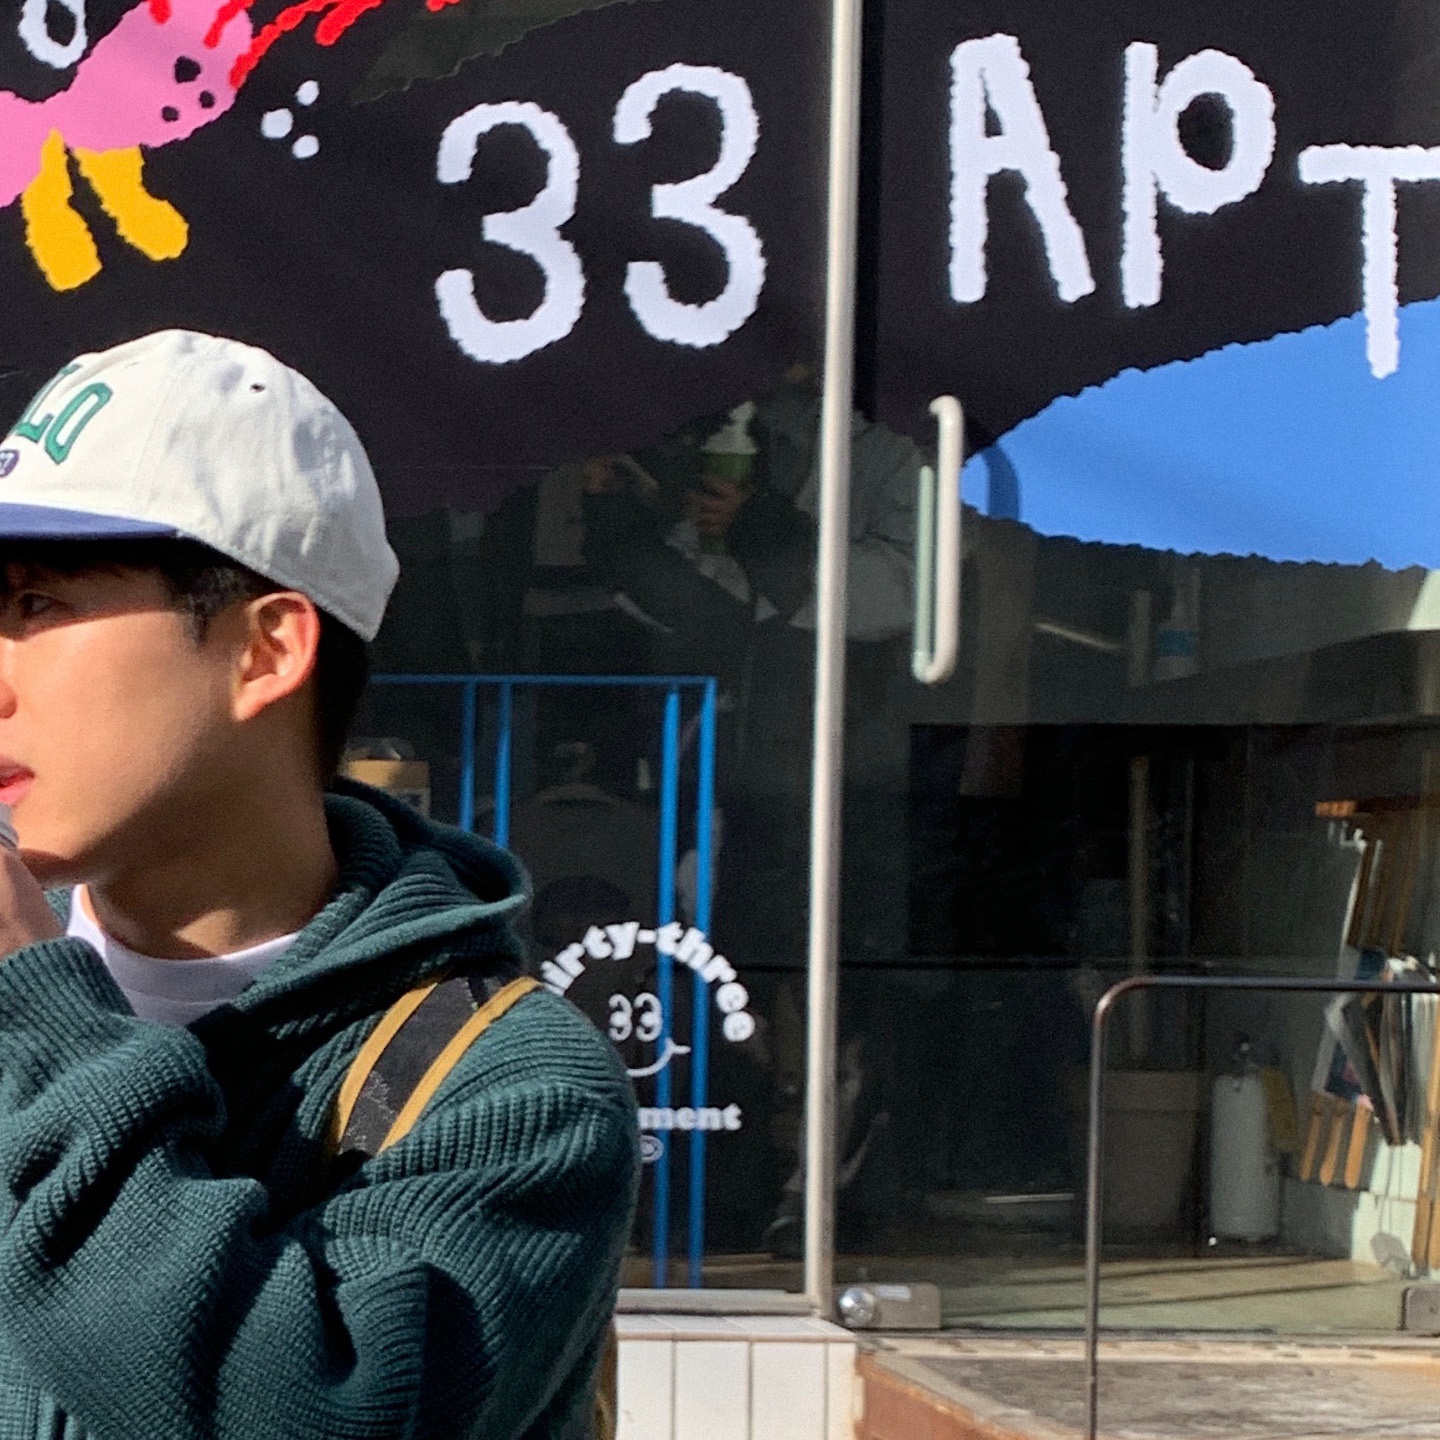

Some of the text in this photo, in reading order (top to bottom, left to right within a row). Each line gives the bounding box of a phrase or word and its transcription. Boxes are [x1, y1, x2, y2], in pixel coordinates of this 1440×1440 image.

[435, 32, 1440, 380] 33 APT
[539, 921, 756, 1043] irty-three
[608, 992, 662, 1042] 33
